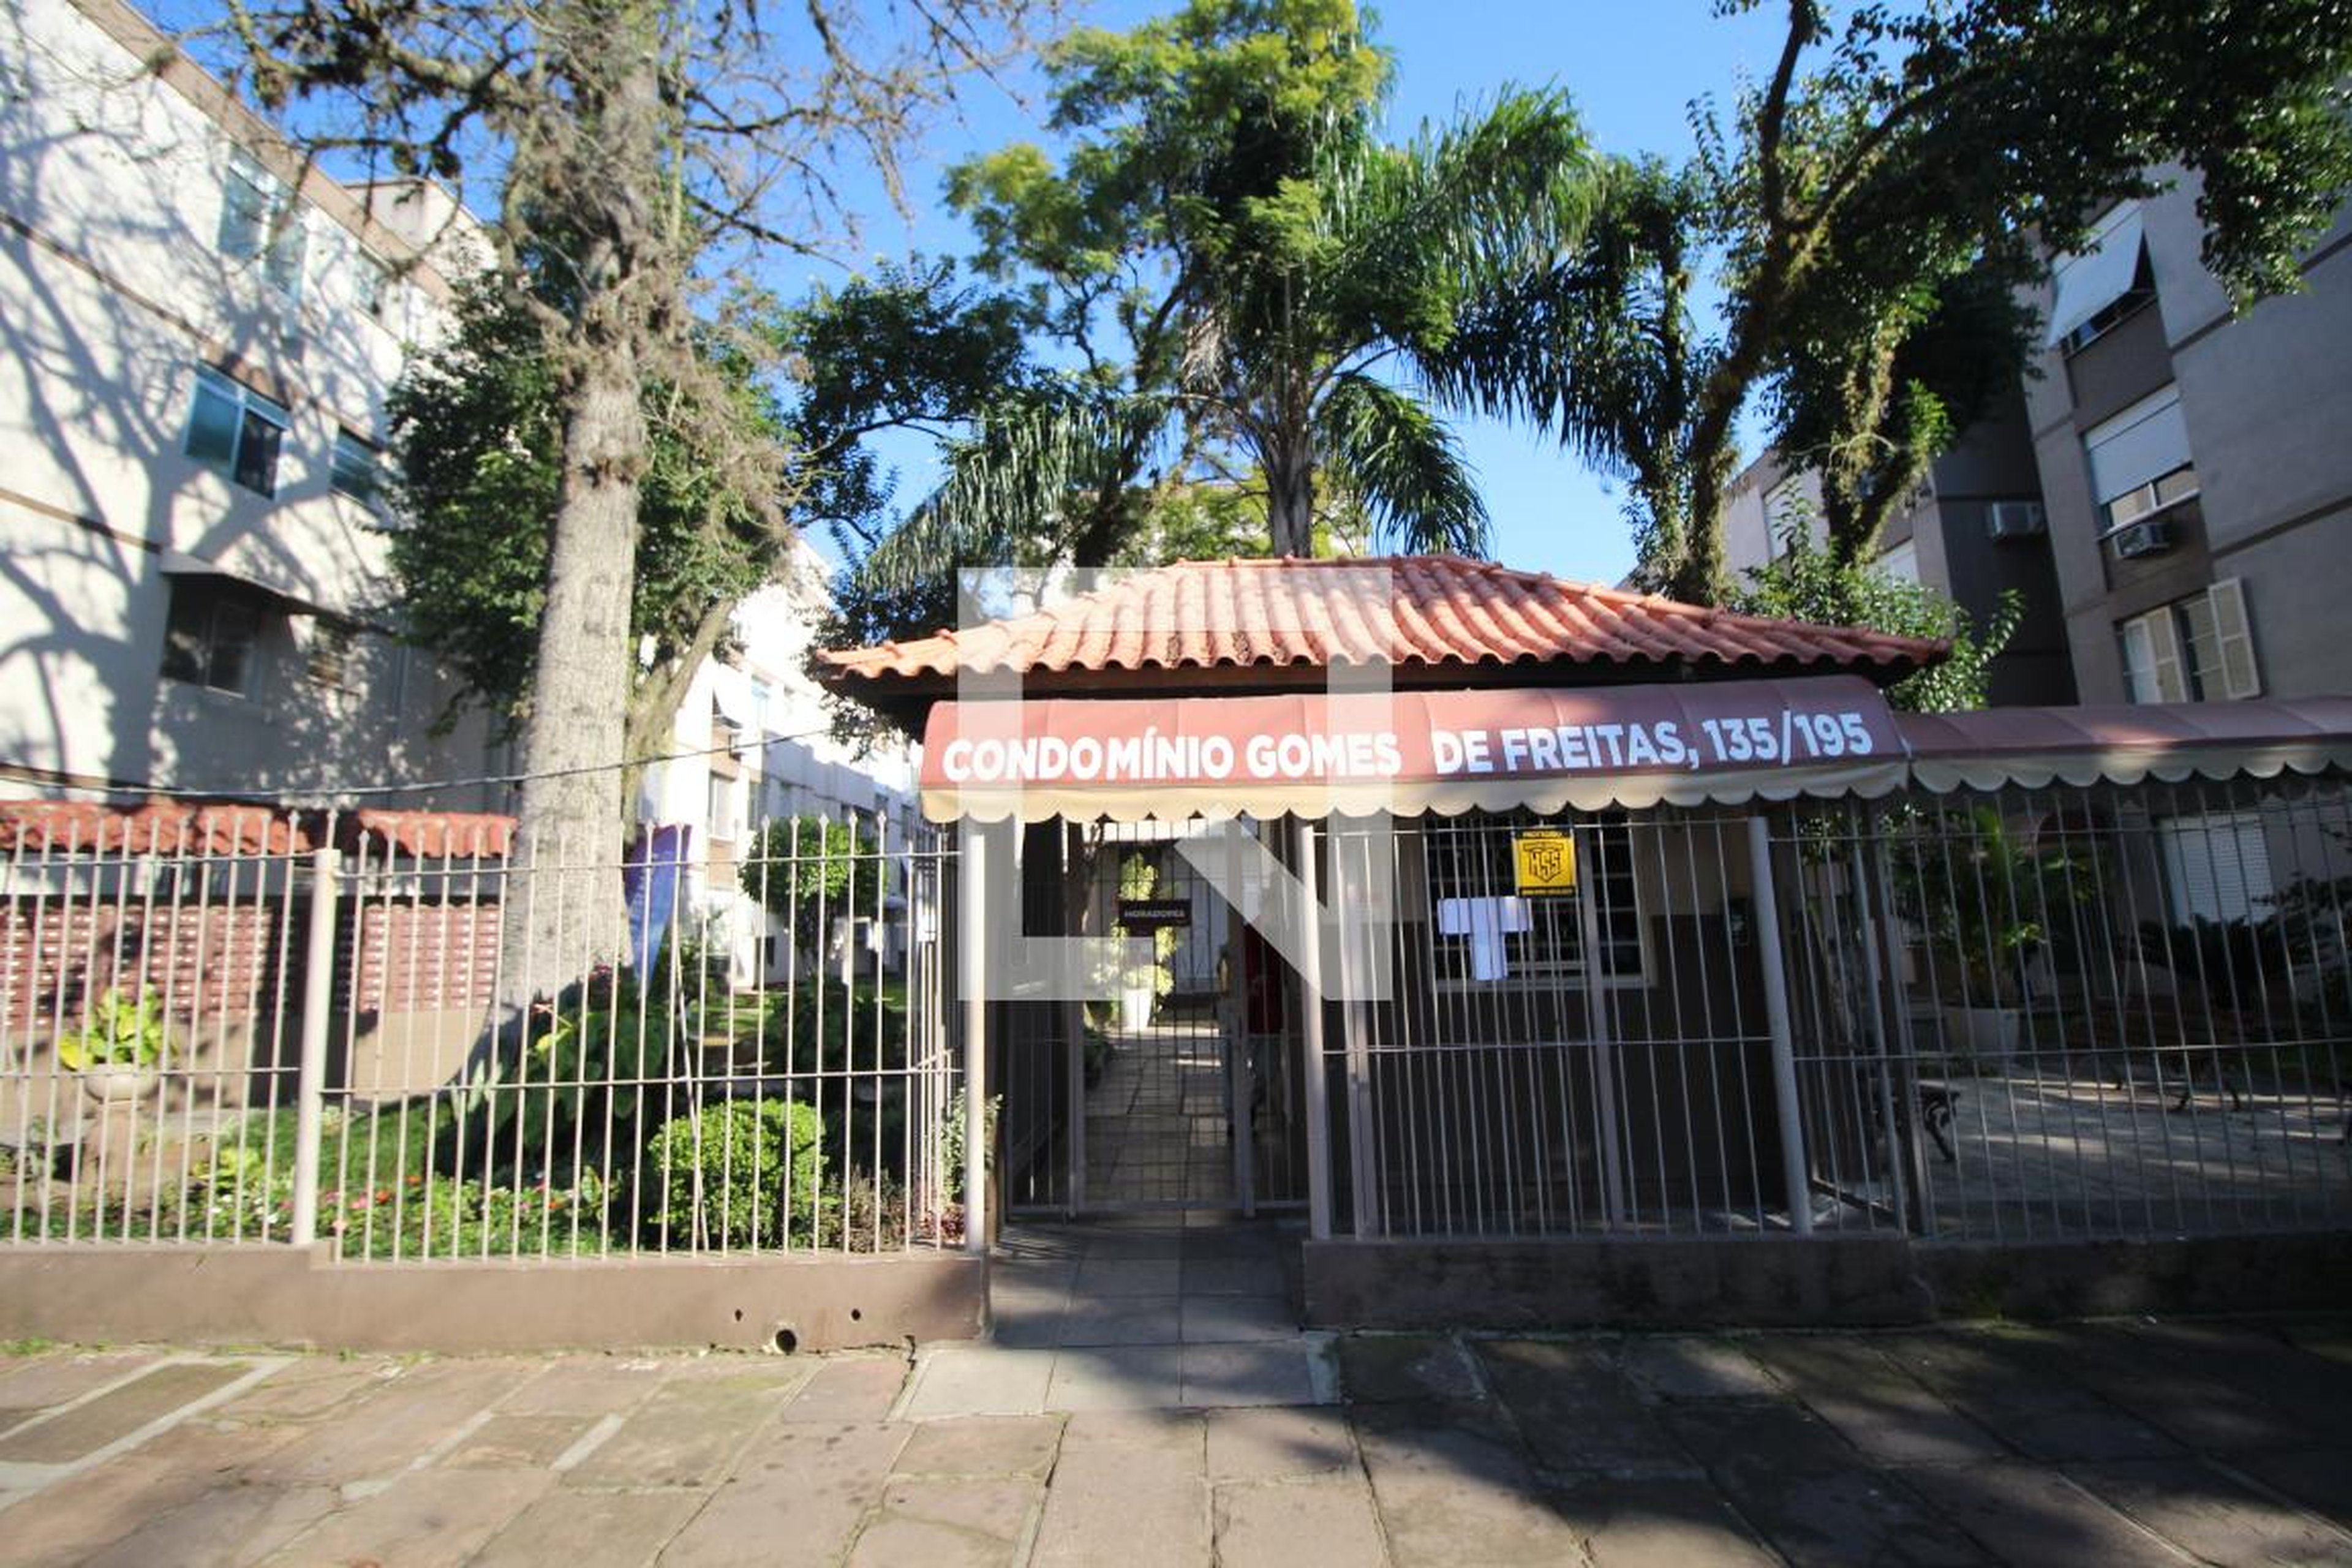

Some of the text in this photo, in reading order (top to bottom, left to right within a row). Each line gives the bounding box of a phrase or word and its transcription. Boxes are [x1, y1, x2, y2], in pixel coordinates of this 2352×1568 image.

[941, 709, 1873, 782] CONDOMÍNIO GOMES DE FREITAS, 135/195
